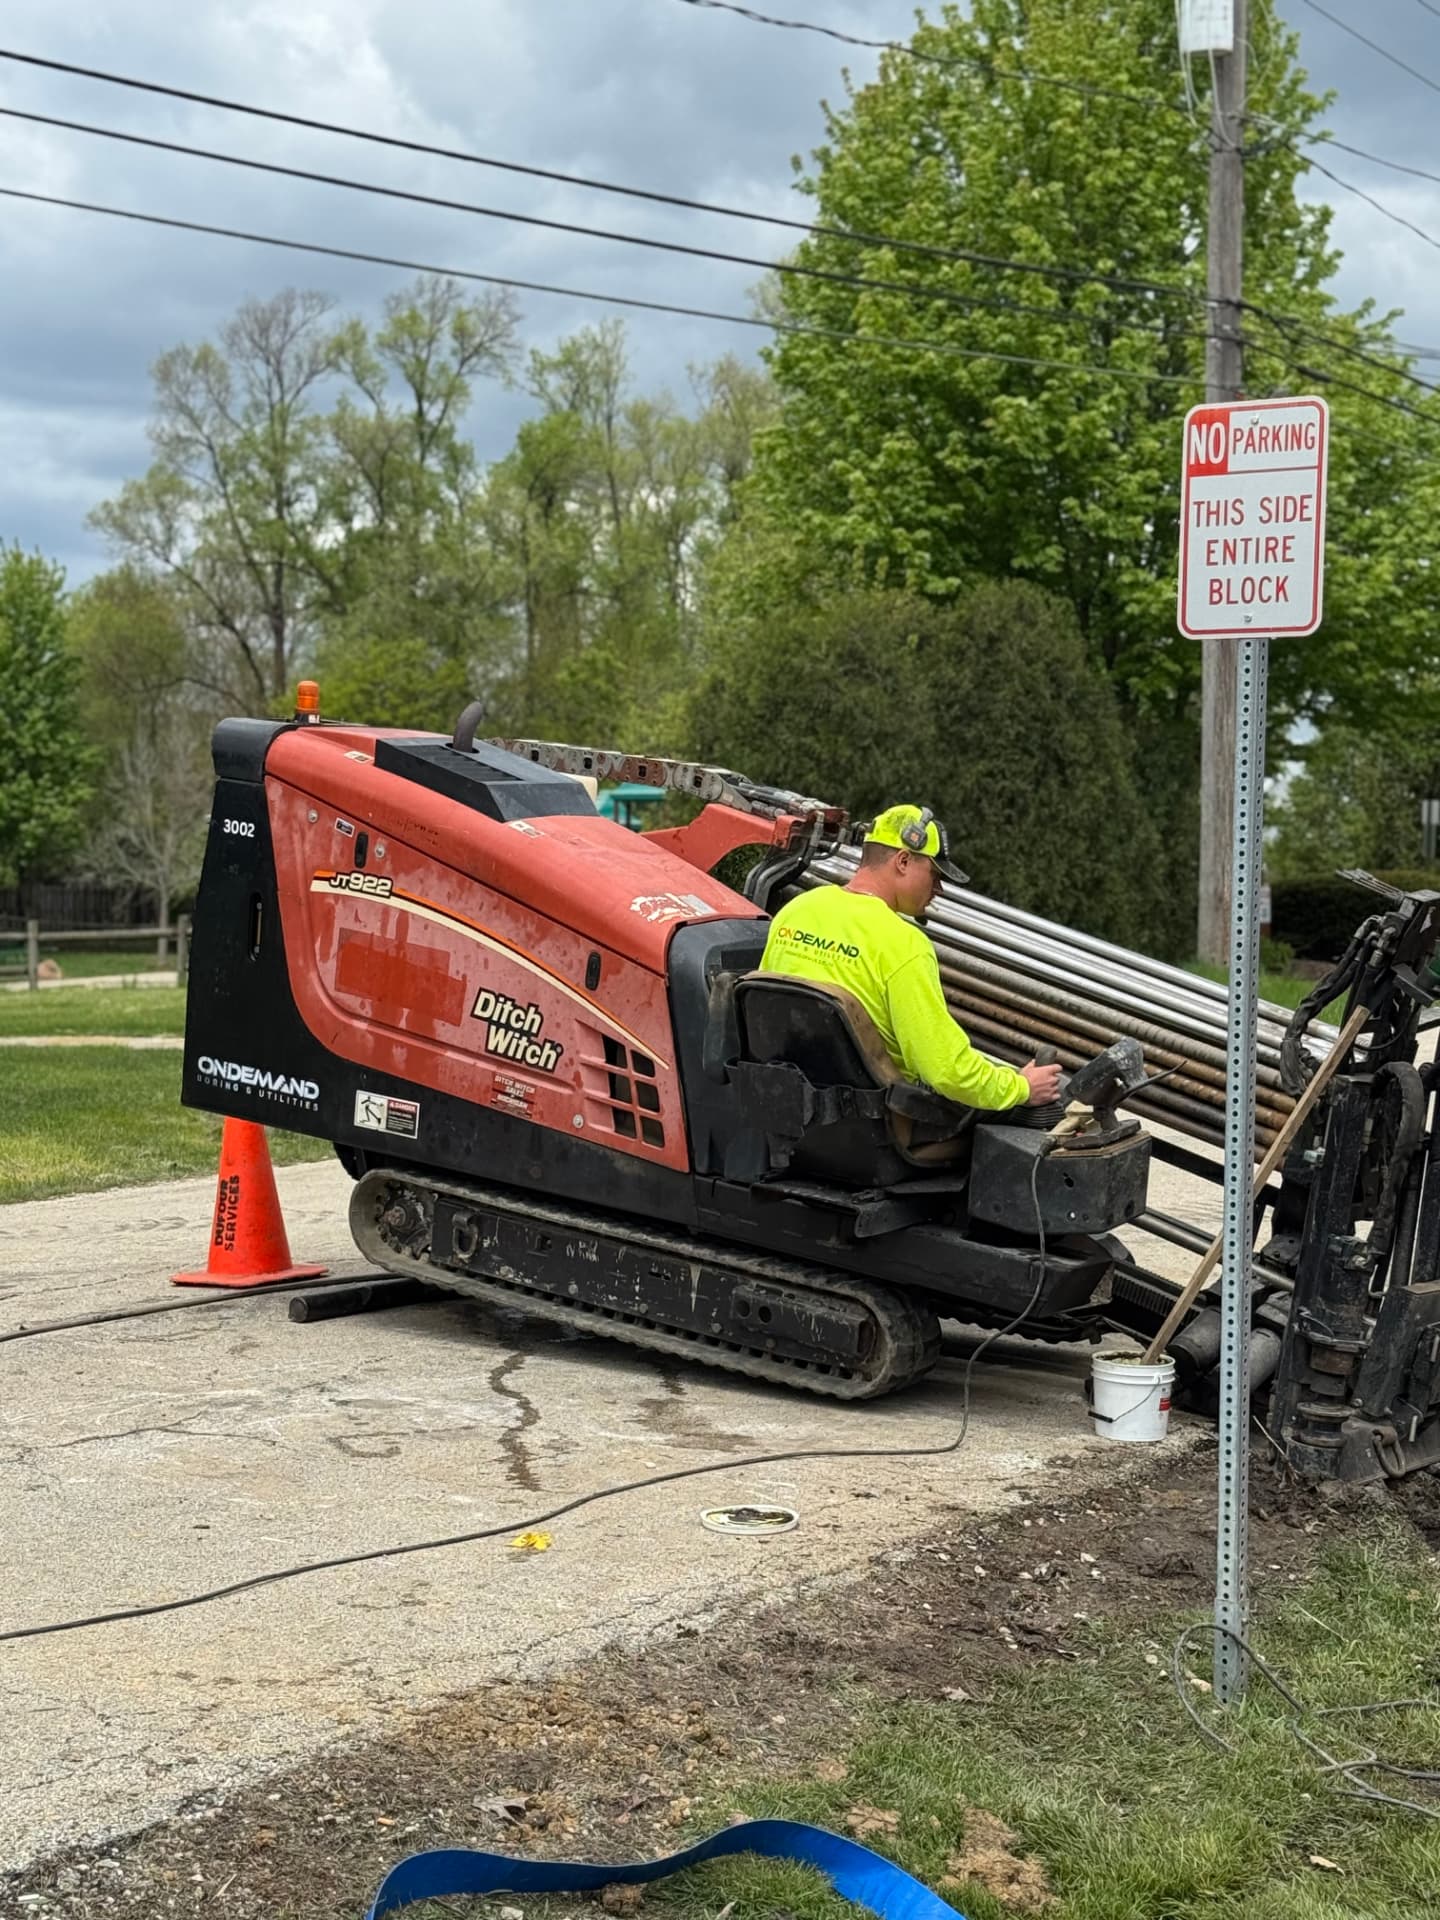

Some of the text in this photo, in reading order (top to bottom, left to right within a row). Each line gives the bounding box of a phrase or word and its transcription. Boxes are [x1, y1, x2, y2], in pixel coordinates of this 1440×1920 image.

[1189, 422, 1316, 465] NO PARKING
[1193, 494, 1313, 528] THIS SIDE
[1206, 535, 1296, 567] ENTIRE
[1208, 575, 1289, 606] BLOCK
[223, 818, 256, 838] 3002
[329, 871, 393, 897] JT922
[778, 927, 860, 958] ONDEMAND
[473, 990, 543, 1035] Ditch
[486, 1024, 559, 1071] Witch
[197, 1055, 320, 1100] ONDEMAND
[258, 1088, 319, 1112] UTILITIES
[214, 1180, 229, 1247] DUFOUR
[225, 1175, 240, 1252] SERVICES
